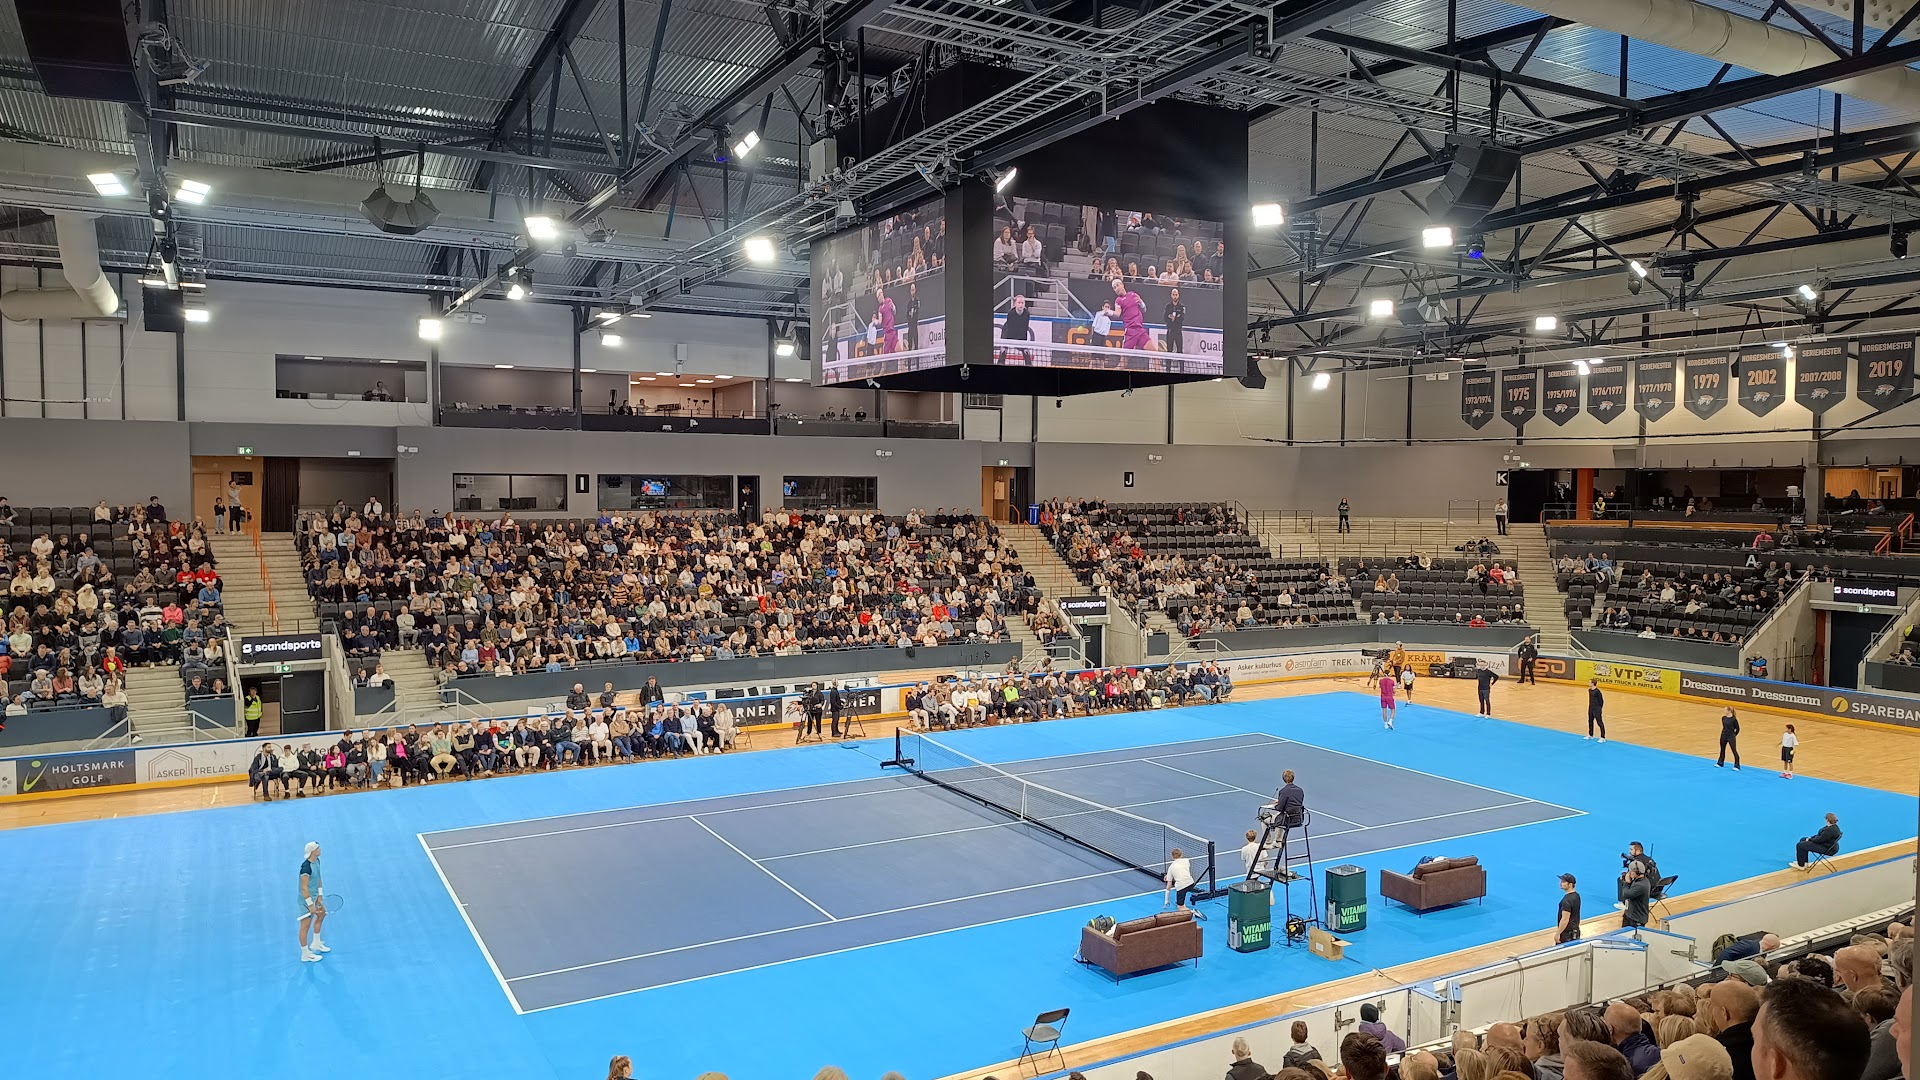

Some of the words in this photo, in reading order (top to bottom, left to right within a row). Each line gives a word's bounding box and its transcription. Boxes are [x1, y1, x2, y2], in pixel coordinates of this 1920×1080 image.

[1801, 346, 1842, 358] SERIEMESTER
[1861, 340, 1913, 353] NORGESMESTER
[1639, 361, 1672, 371] SERIEMESTER
[1686, 356, 1727, 367] NORGESMESTER
[1868, 359, 1904, 378] 2019
[1693, 373, 1720, 390] 1979
[1747, 368, 1777, 386] 2002
[1800, 370, 1842, 383] 2007/2008
[1508, 386, 1530, 402] 1975
[1546, 389, 1577, 399] 1975/1976
[1591, 385, 1623, 396] 1976/1977
[1638, 382, 1672, 394] 1977/1978
[1125, 473, 1133, 486] J
[1497, 472, 1508, 485] K
[1745, 554, 1758, 567] A
[1843, 586, 1896, 598] scandsports
[254, 639, 321, 652] scandsports
[1614, 667, 1643, 680] VTP
[1682, 678, 1746, 696] Dressmann
[1751, 687, 1821, 706] Dressmann
[52, 760, 125, 774] HOLTSMARK
[156, 768, 186, 779] ASKER
[193, 764, 236, 775] TRELAST
[72, 774, 103, 785] GOLF
[1340, 914, 1360, 924] WELL
[1243, 932, 1263, 944] WELL
